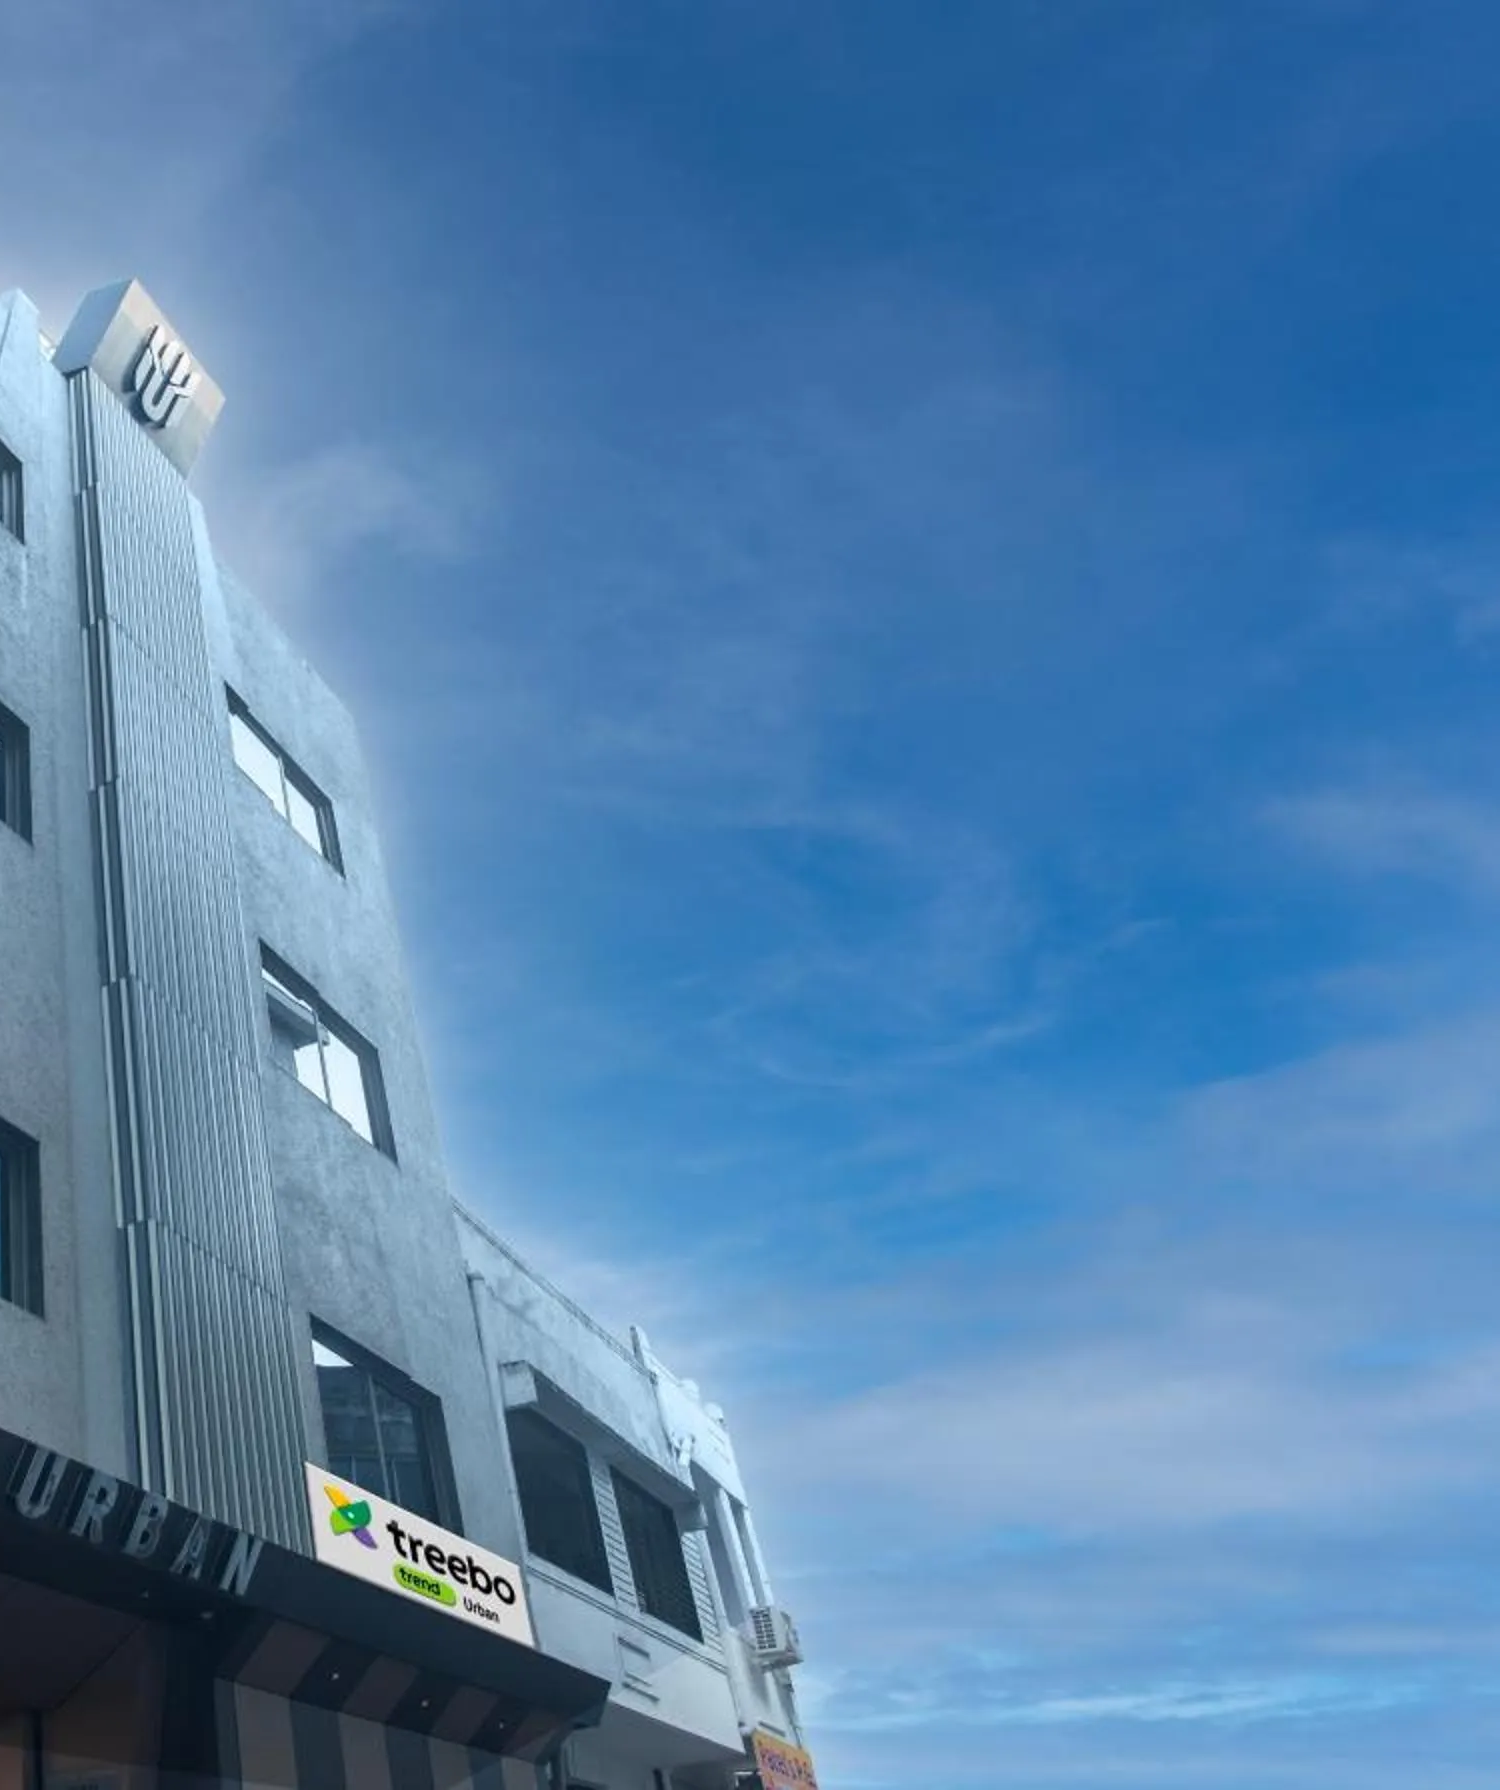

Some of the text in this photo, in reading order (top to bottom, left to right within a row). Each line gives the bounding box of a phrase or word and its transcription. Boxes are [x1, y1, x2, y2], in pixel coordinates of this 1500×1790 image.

[8, 1447, 264, 1597] URBAN
[386, 1519, 516, 1606] treebo
[398, 1567, 442, 1596] trend
[463, 1596, 501, 1624] Urban
